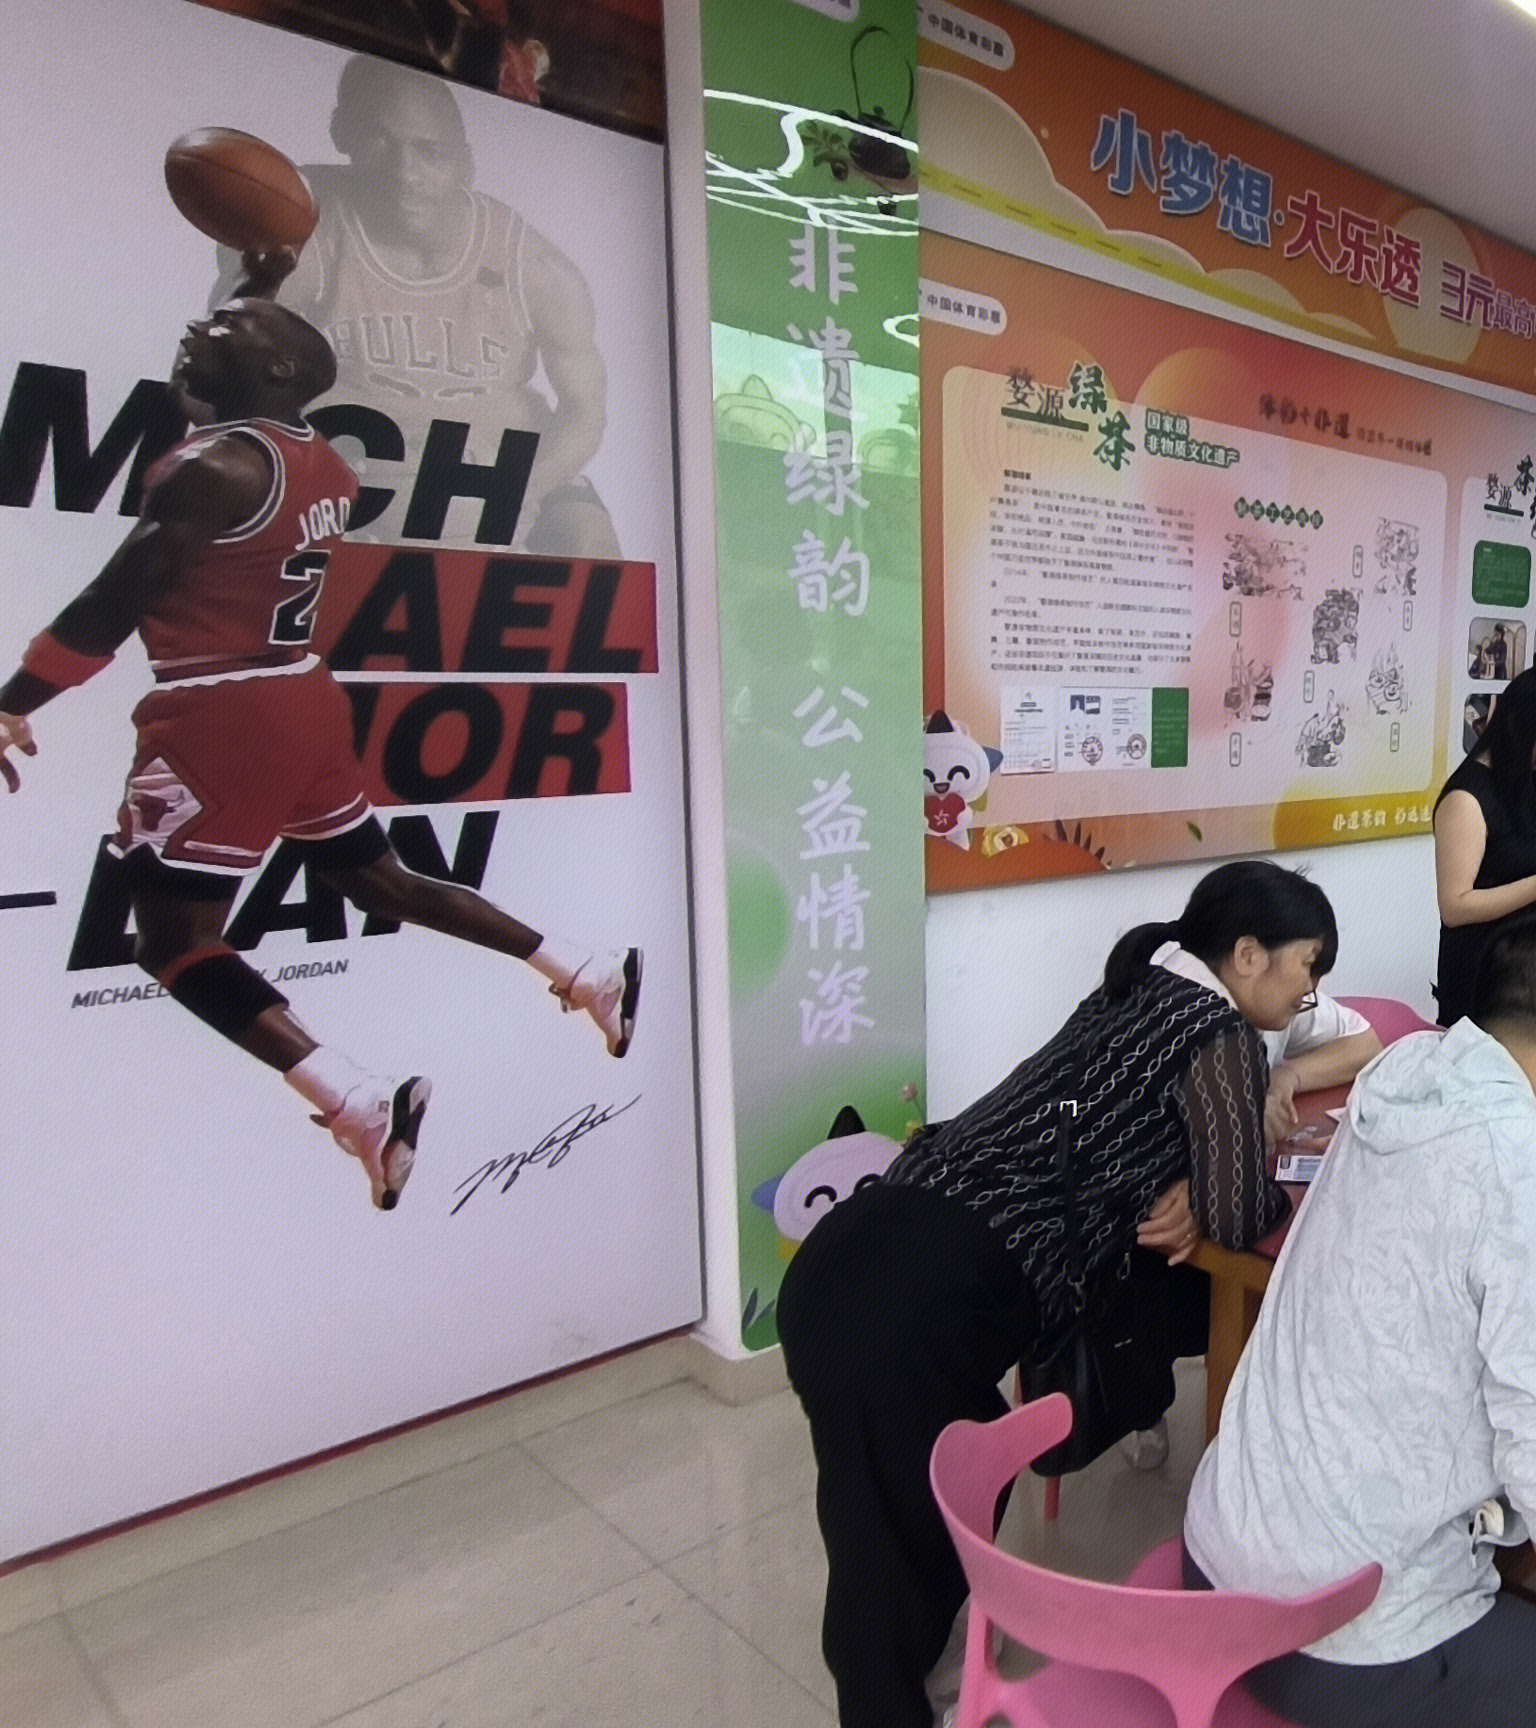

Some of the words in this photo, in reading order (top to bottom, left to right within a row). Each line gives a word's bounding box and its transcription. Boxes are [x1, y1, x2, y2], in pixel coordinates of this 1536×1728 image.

[0, 361, 540, 547] MCH
[1145, 432, 1240, 468] 非物质文化遗产
[1147, 409, 1190, 437] 国家级
[342, 681, 617, 803] OR
[792, 686, 875, 1046] 公益情深
[271, 958, 350, 984] JORDAN
